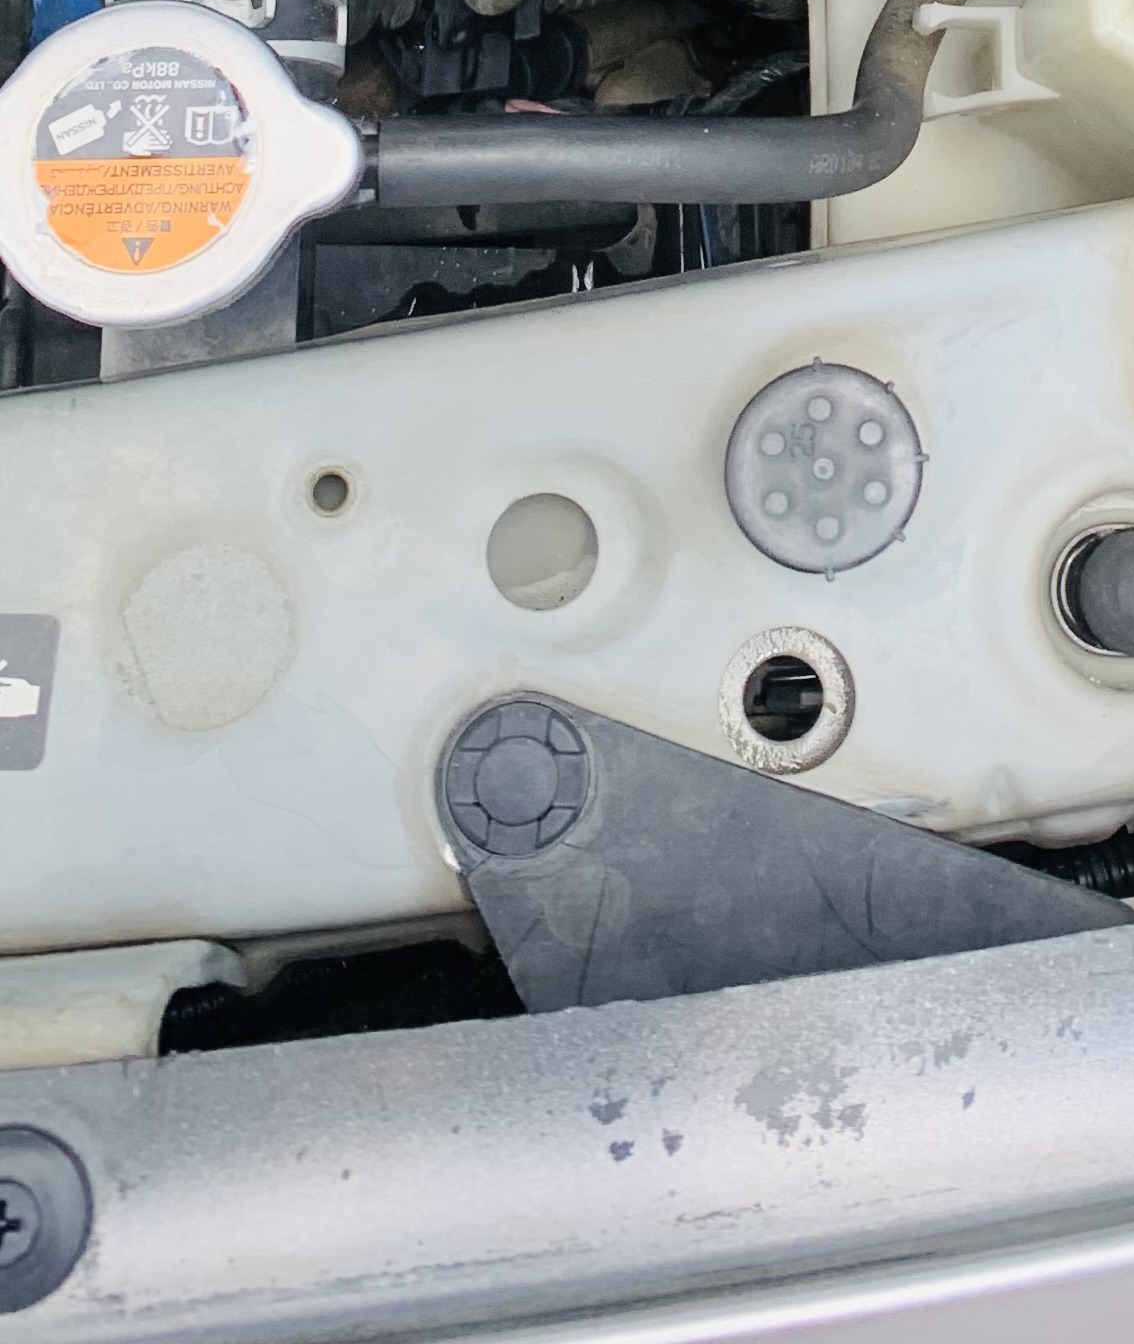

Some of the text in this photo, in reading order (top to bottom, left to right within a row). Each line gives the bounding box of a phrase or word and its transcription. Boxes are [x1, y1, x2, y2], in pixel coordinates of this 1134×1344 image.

[122, 61, 180, 78] 88kPa
[132, 80, 172, 90] MOTOR
[174, 79, 216, 89] NISSAN
[56, 117, 97, 143] NISSAN
